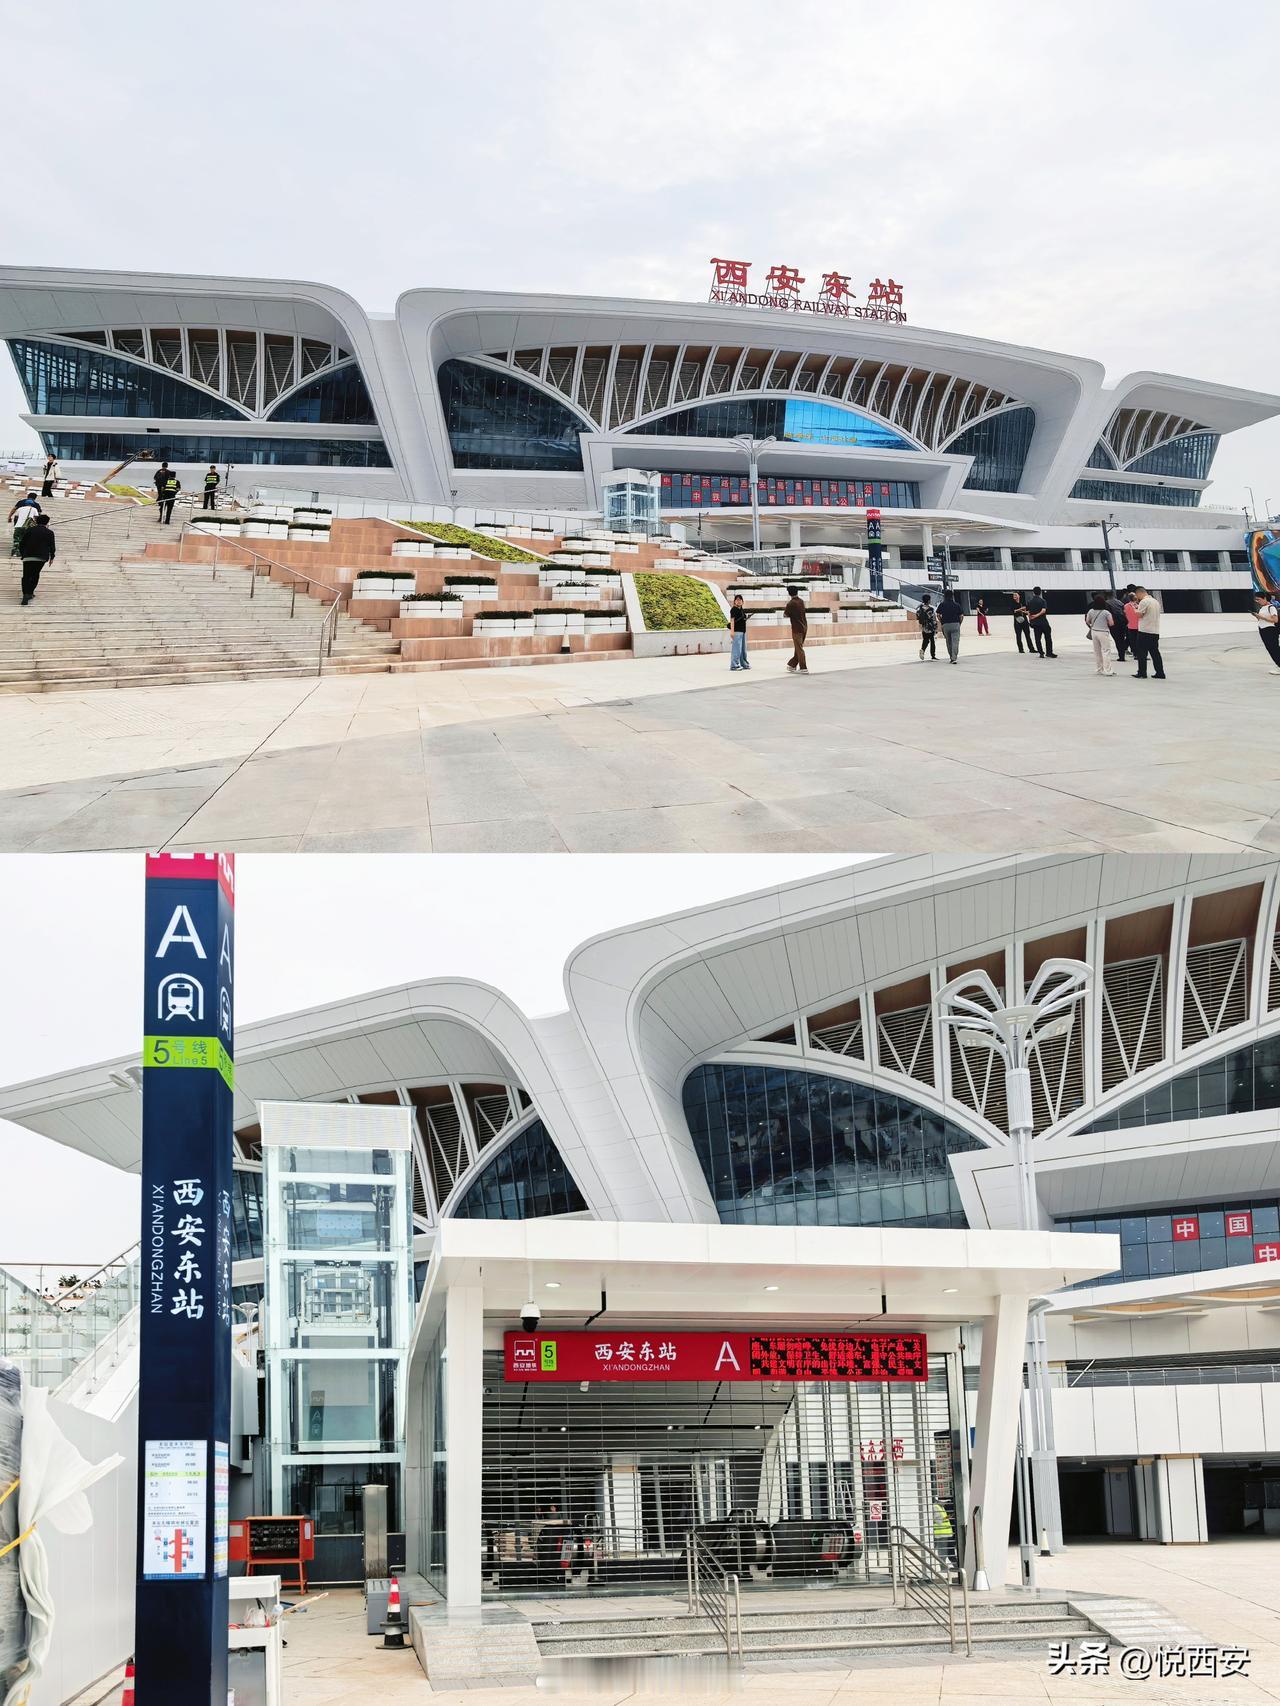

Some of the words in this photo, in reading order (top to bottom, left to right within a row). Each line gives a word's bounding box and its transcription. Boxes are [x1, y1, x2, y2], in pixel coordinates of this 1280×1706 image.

[710, 258, 904, 304] 西安东站
[793, 299, 850, 317] RAILWAY
[854, 307, 908, 323] STATION
[868, 522, 874, 530] A
[155, 905, 207, 959] A
[219, 922, 233, 985] A
[153, 1039, 171, 1065] 5
[172, 1040, 208, 1055] 号线
[173, 1056, 198, 1065] Line
[200, 1056, 208, 1066] 5
[1176, 1216, 1248, 1238] 中国
[150, 1184, 165, 1314] XI'ANDONGZHAN
[170, 1178, 206, 1320] 西安东站
[1258, 1245, 1278, 1262] 中
[544, 1345, 554, 1358] 5
[594, 1342, 677, 1361] 西安东站
[714, 1341, 741, 1371] A
[602, 1364, 671, 1372] XI'ANDONGZHAN
